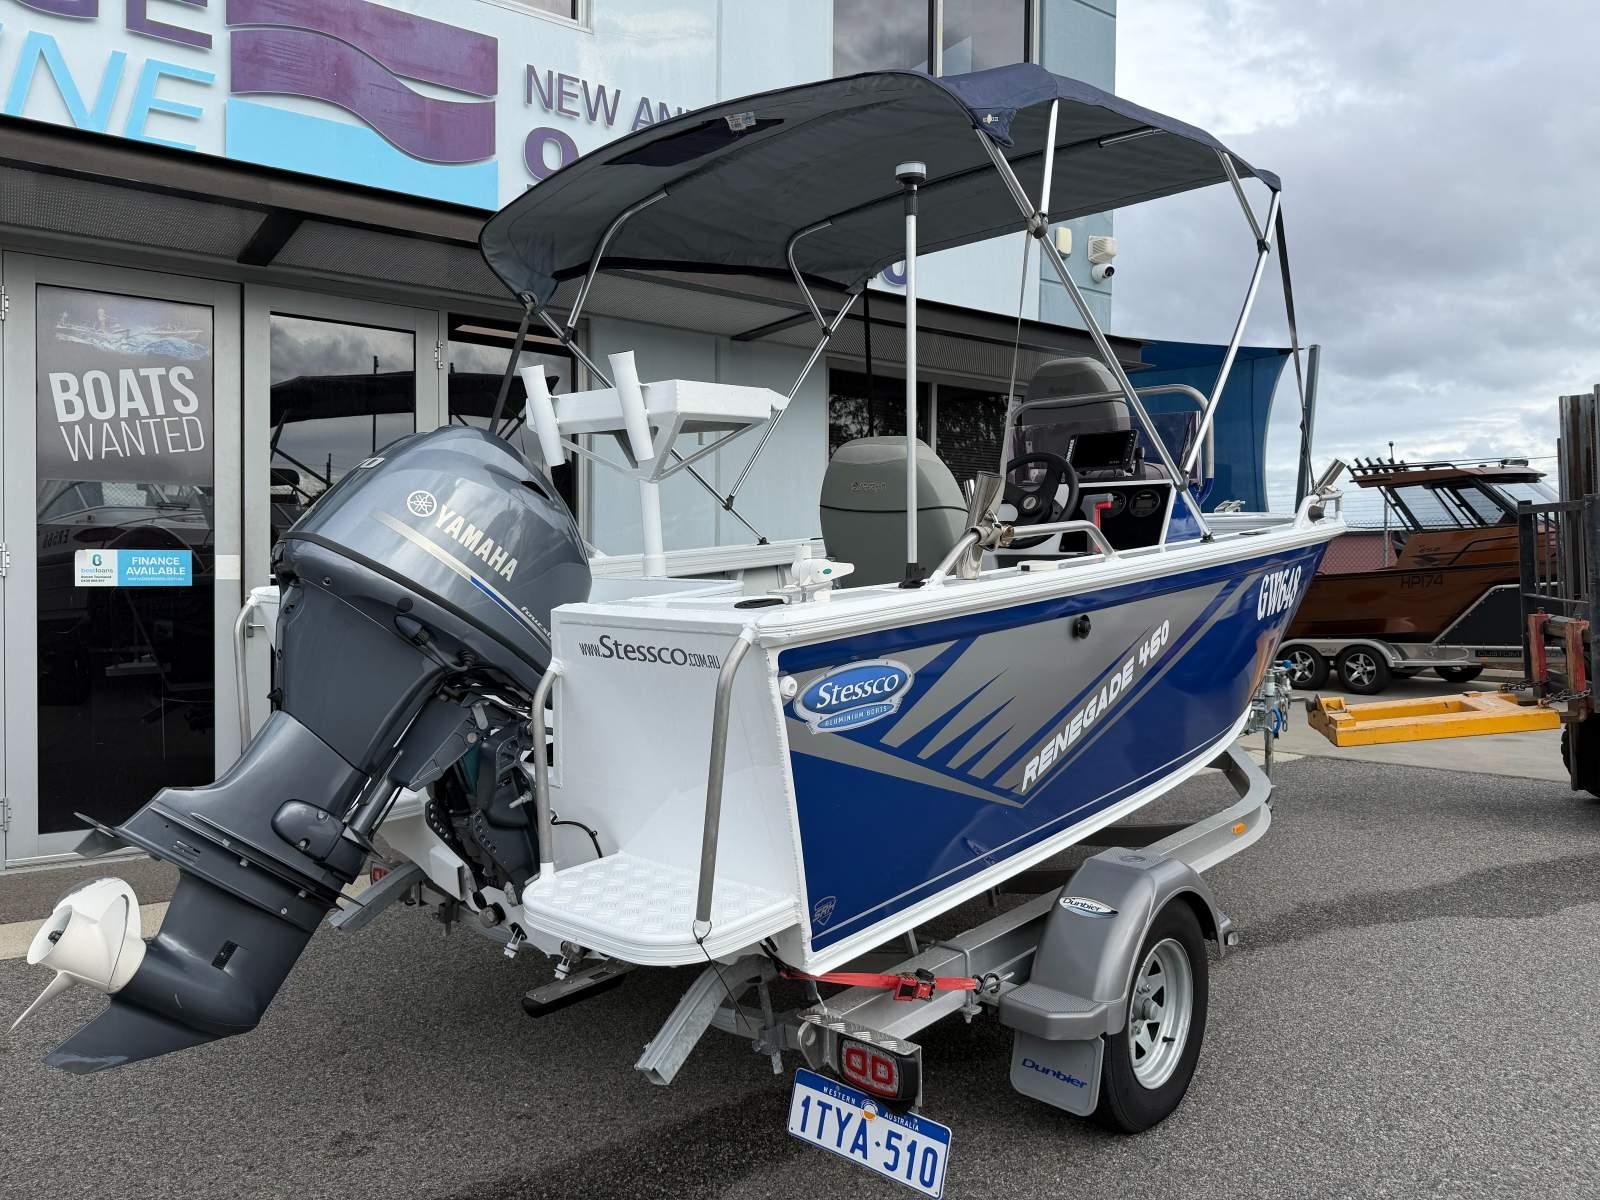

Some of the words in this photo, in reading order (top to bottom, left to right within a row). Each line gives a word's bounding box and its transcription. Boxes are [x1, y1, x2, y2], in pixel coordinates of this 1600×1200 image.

[526, 63, 621, 127] NEW
[49, 365, 199, 423] BOATS
[60, 416, 205, 462] WANTED
[131, 556, 180, 566] FINANCE
[434, 504, 518, 582] YAMAHA
[126, 566, 186, 576] AVAILABLE
[815, 673, 900, 709] Stessco
[1021, 655, 1136, 793] RENEGADE
[1138, 619, 1170, 669] 460
[1062, 897, 1100, 912] Dunbier
[1022, 1057, 1088, 1089] Dunbier
[823, 1086, 856, 1105] WESTERN
[883, 1111, 920, 1131] AUSTRALIA
